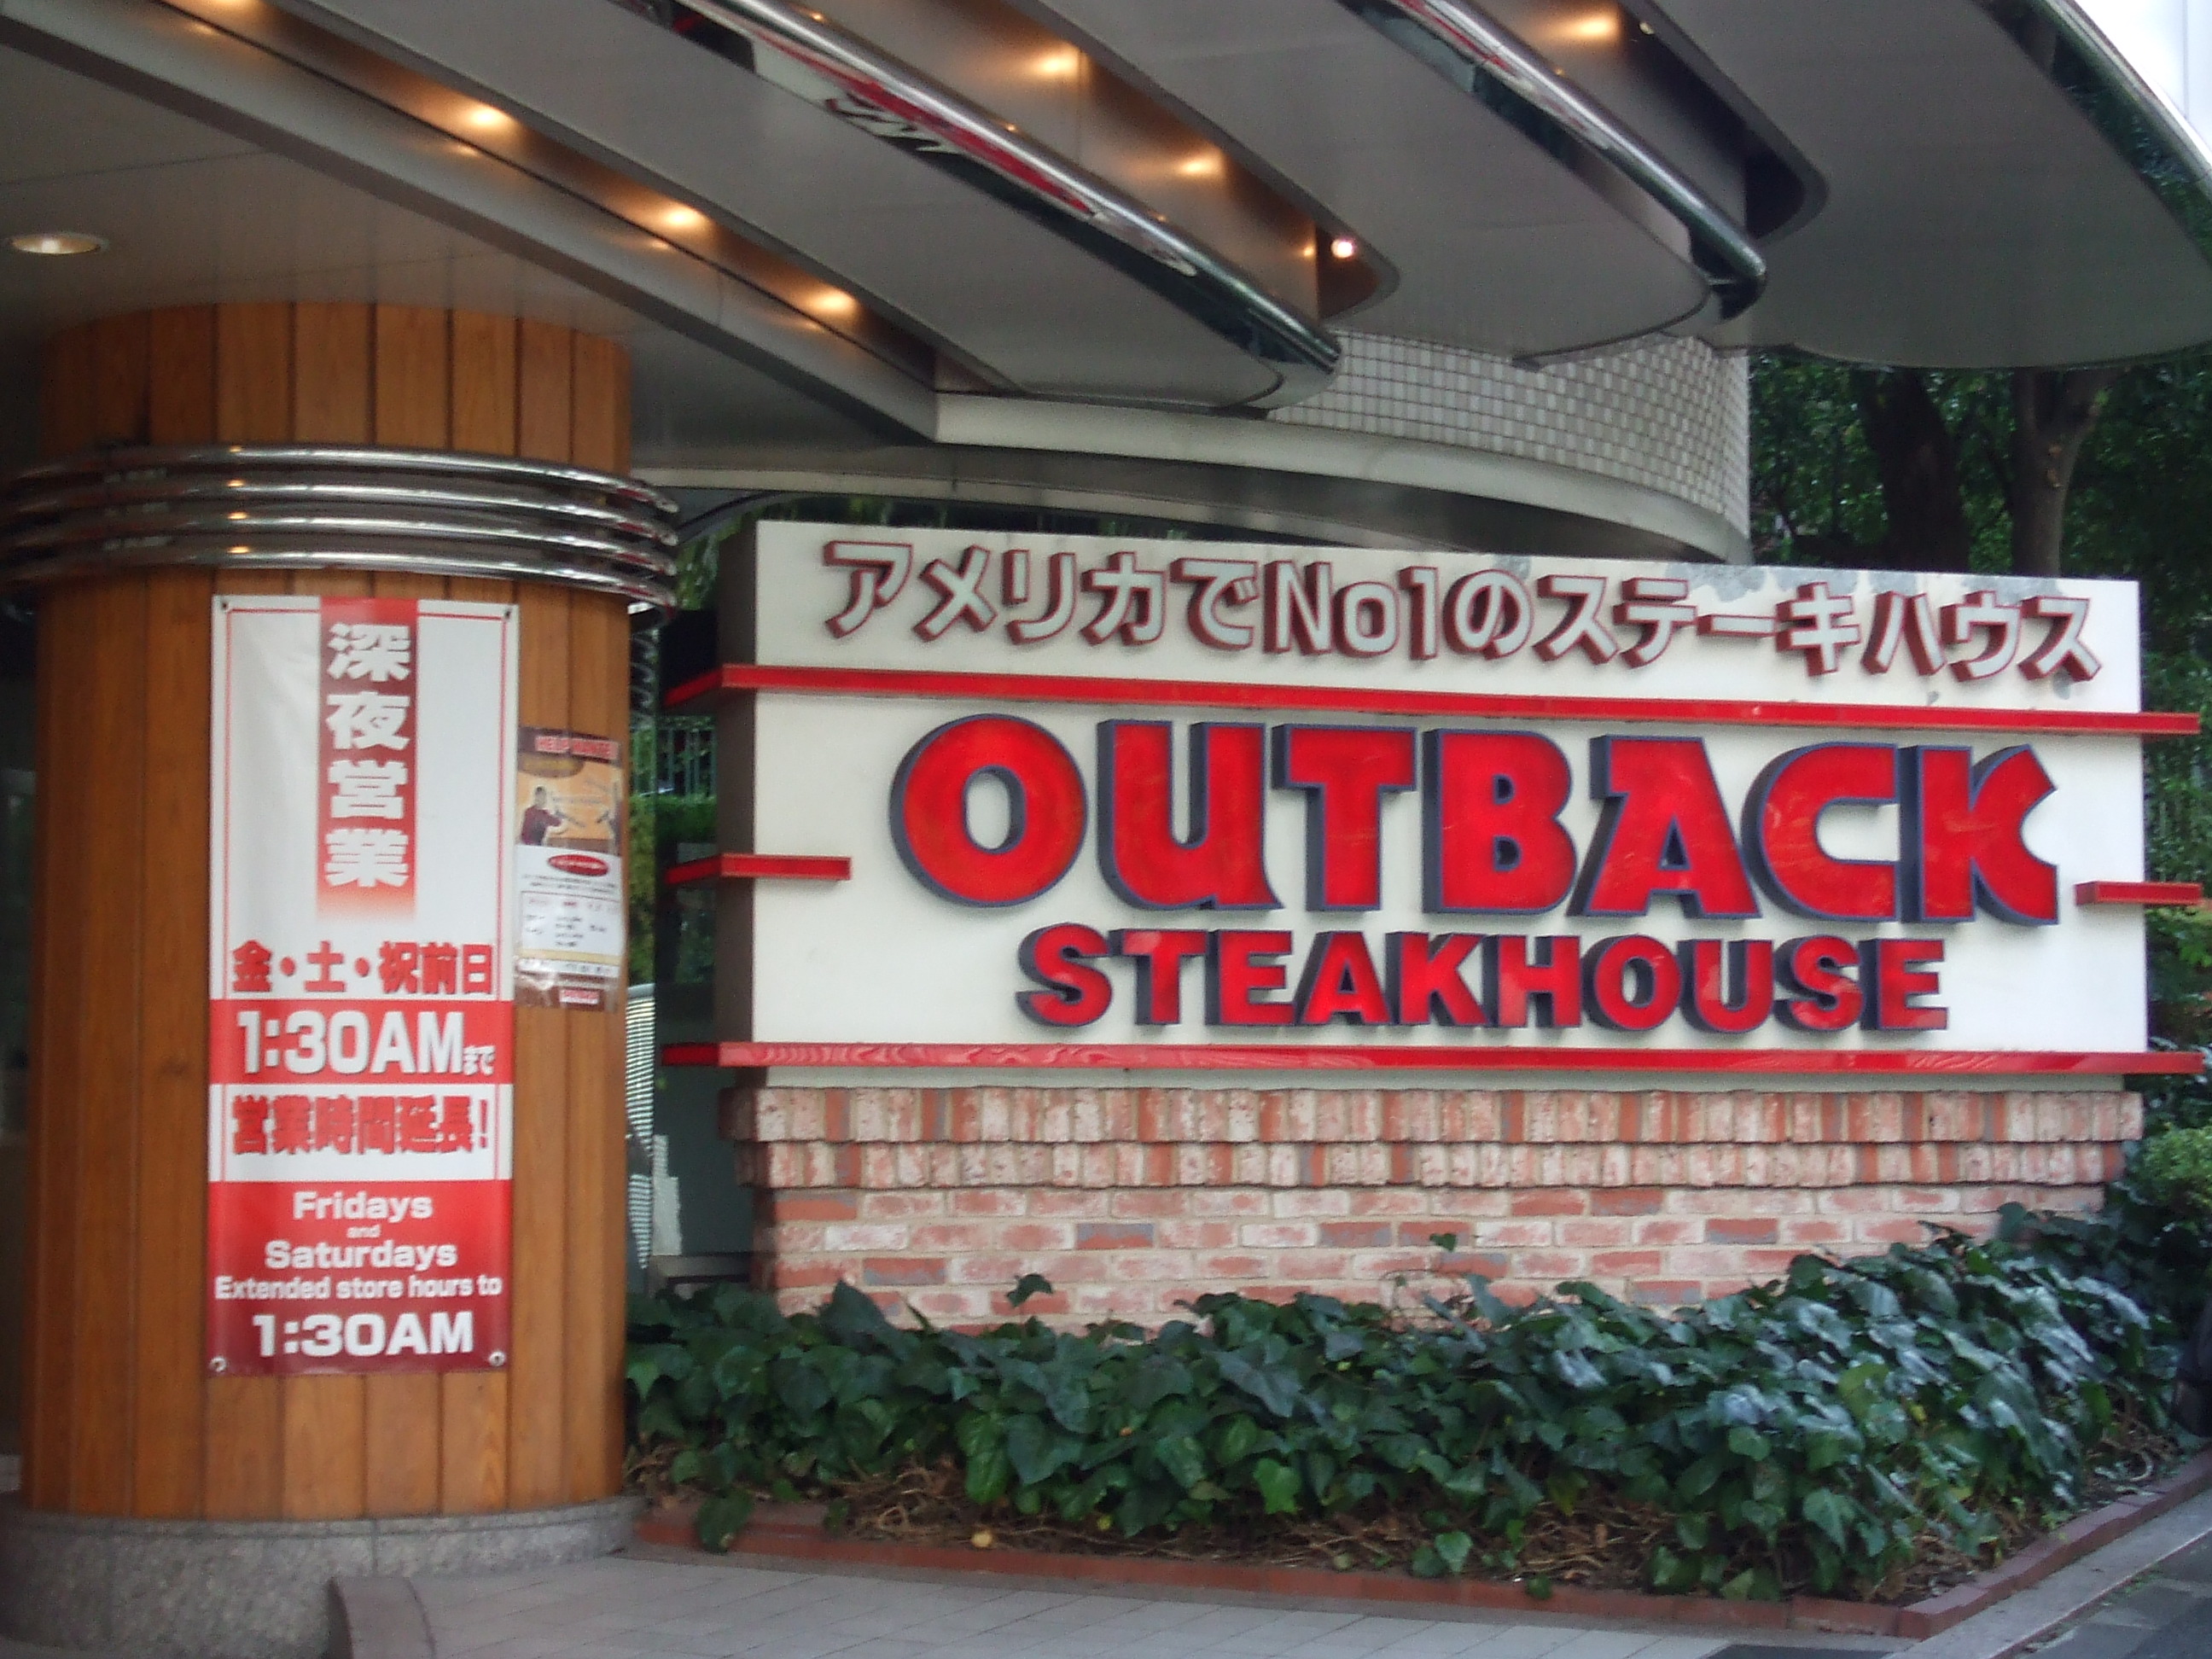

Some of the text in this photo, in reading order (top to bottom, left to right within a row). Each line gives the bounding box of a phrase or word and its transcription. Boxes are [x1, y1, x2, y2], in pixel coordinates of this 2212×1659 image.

[824, 541, 2102, 683] アメリカでNo1のステーキハウス
[325, 624, 410, 888] 深夜営業
[889, 713, 2059, 925] OUTBACK
[1016, 923, 1948, 1033] STEAKHOUSE
[293, 1190, 434, 1222] Fridays
[346, 1225, 381, 1238] and
[265, 1240, 458, 1271] Saturdays
[214, 1274, 503, 1300] Extended store hours to
[253, 1311, 474, 1357] 1:30AM
